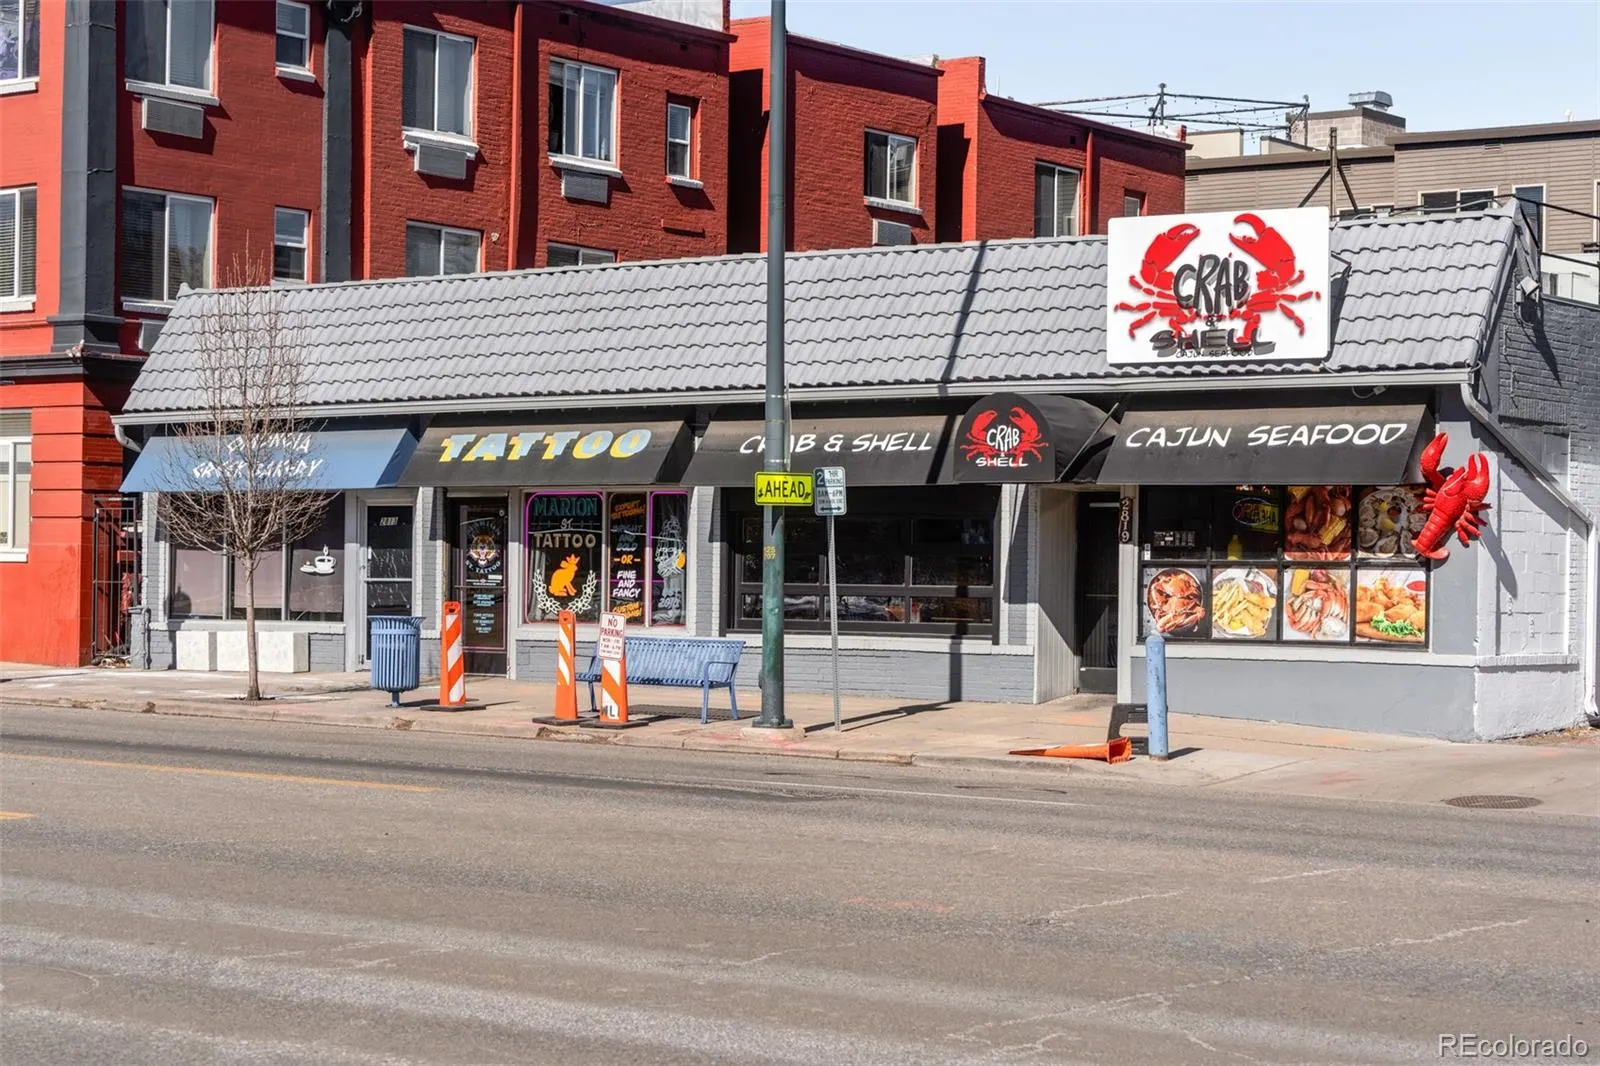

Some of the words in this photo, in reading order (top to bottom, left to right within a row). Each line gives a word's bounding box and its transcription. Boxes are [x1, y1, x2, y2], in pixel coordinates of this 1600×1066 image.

[1173, 253, 1251, 315] CRAB
[1150, 328, 1276, 352] SHELL
[739, 433, 817, 454] CB
[823, 434, 845, 452] &
[851, 432, 933, 452] SHELL
[986, 424, 1020, 452] CRAB
[1125, 426, 1232, 448] CAJUN
[1247, 423, 1409, 447] SEAFOOD
[439, 429, 651, 462] TATTOO
[976, 456, 1029, 467] SHELL
[816, 471, 825, 485] 2
[765, 480, 806, 498] AHEAD
[533, 497, 598, 516] MARION
[1121, 497, 1130, 543] 2819
[534, 532, 597, 549] TATTOO
[617, 570, 637, 580] FINE
[612, 588, 642, 599] FANCY
[618, 580, 636, 589] AND
[607, 617, 618, 628] NO
[600, 627, 625, 639] PARKING
